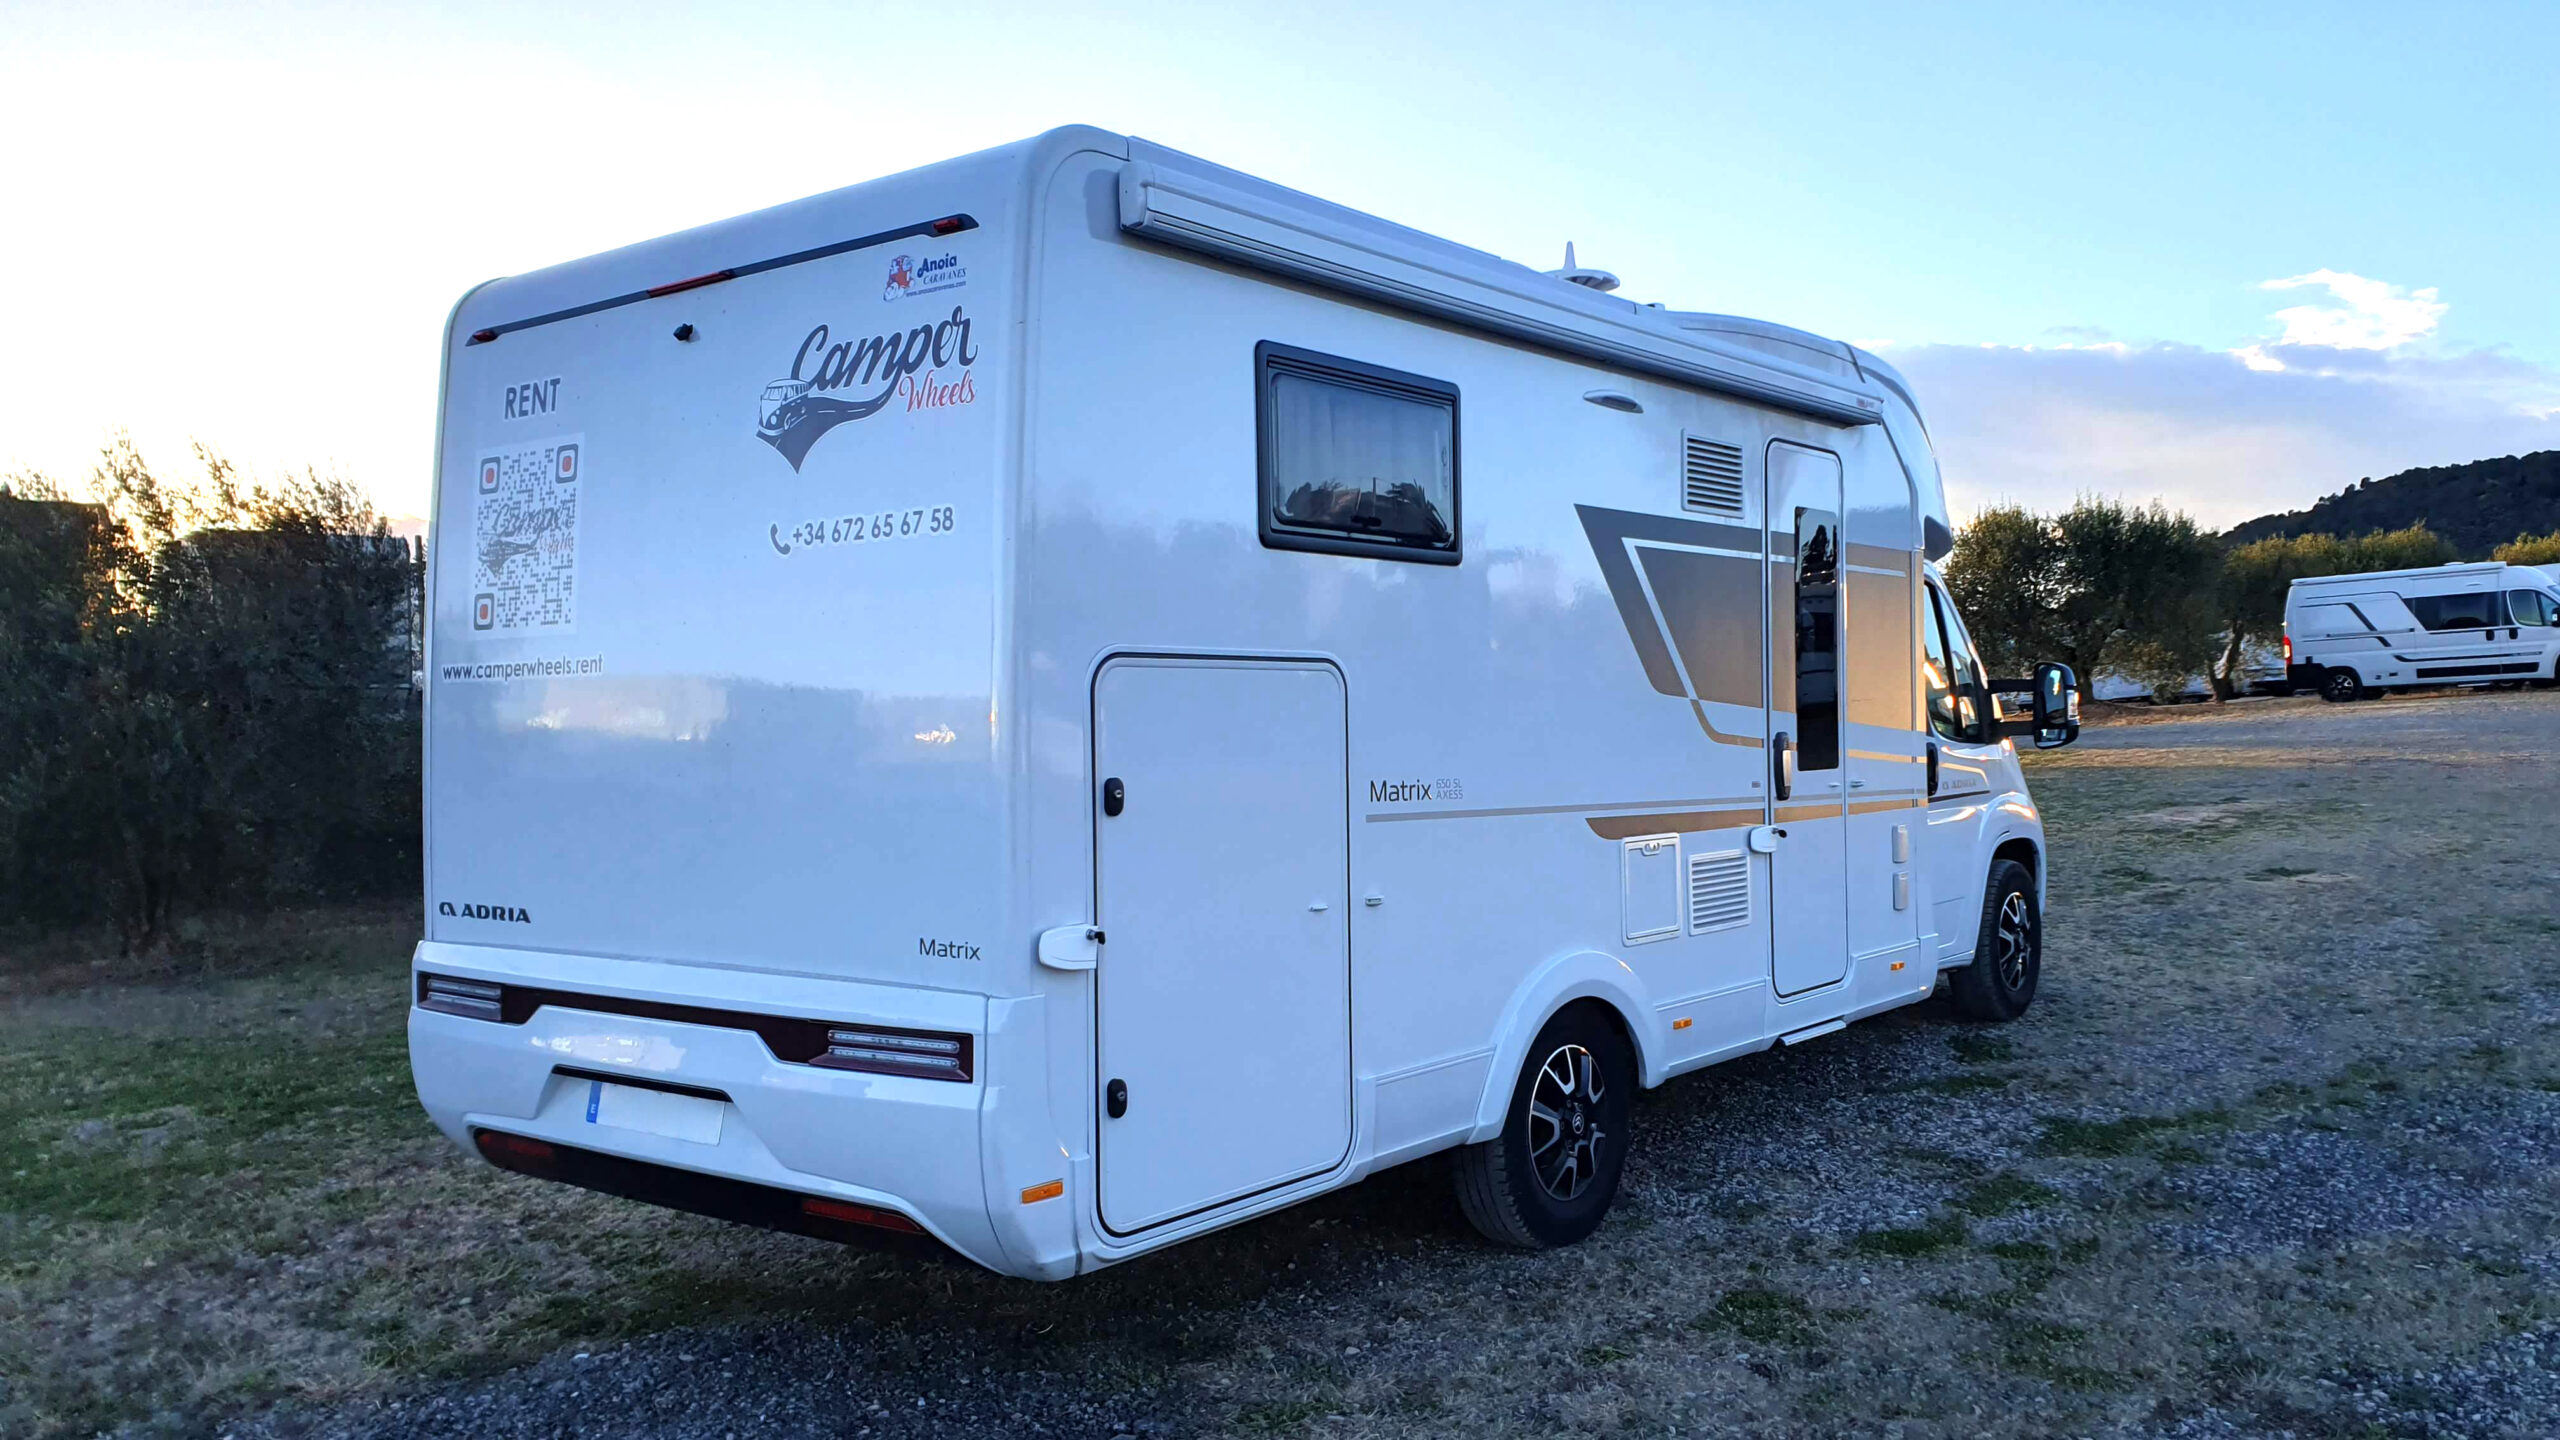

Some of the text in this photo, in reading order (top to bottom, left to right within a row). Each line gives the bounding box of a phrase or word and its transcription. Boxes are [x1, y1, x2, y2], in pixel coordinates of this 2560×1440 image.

[917, 253, 958, 278] Anoia
[791, 305, 978, 393] Camper
[504, 378, 561, 420] RENT
[899, 369, 975, 413] Wheels
[793, 507, 954, 546] +34 672 65 67 58
[443, 654, 603, 681] www.camperwheels.rent
[1370, 779, 1432, 802] Matrix
[1436, 789, 1464, 800] AXESS
[461, 903, 532, 924] ADRIA
[919, 937, 981, 961] Matrix
